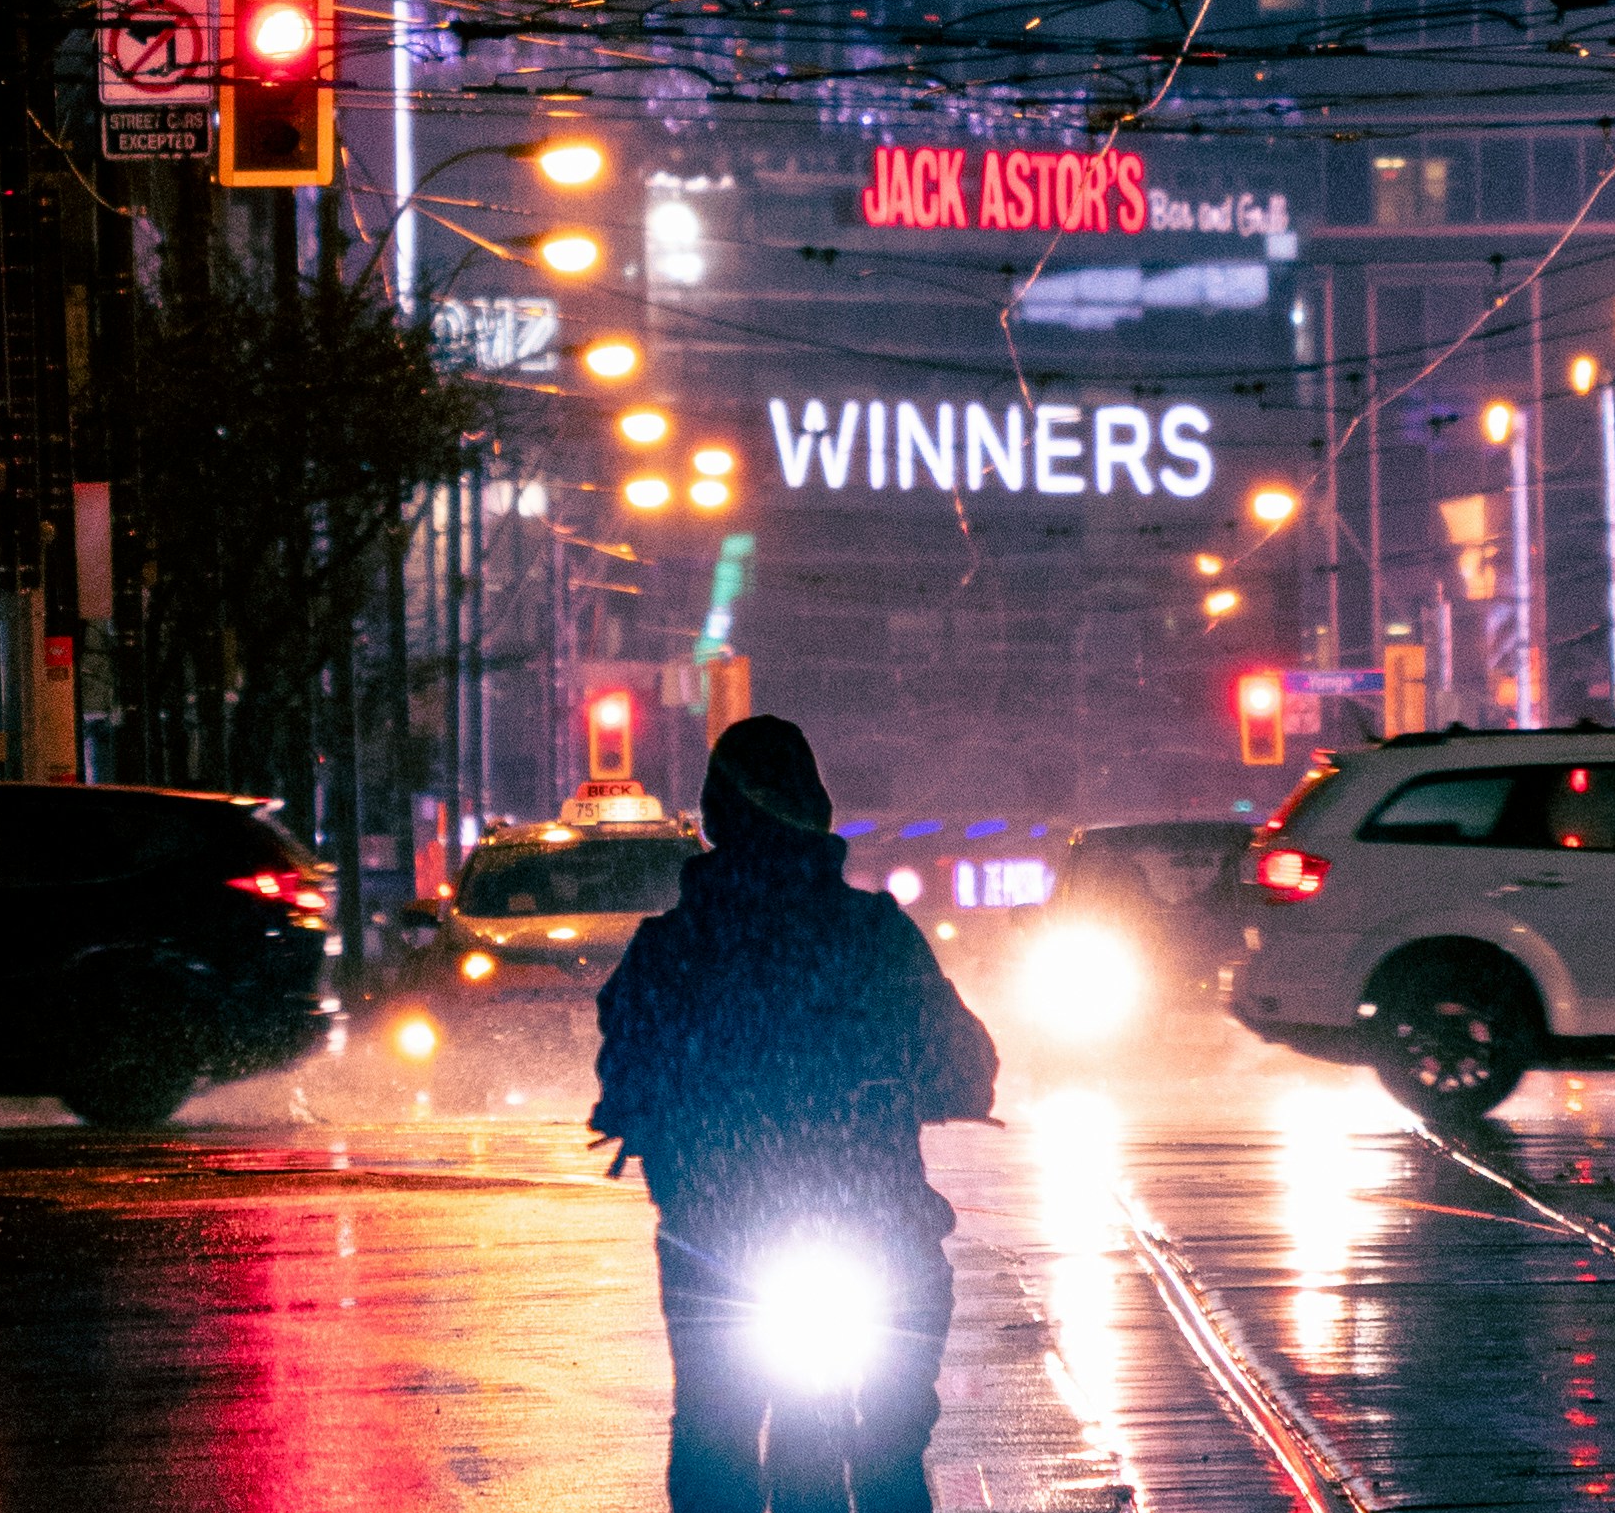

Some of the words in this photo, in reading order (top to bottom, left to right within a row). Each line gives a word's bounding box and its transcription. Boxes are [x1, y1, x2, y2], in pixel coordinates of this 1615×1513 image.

[110, 112, 160, 130] STREET
[118, 132, 196, 151] EXCEPTED
[862, 146, 967, 229] JACK
[980, 147, 1146, 233] ASTOR'S
[767, 397, 1214, 498] WINNERS
[587, 784, 632, 798] BECK
